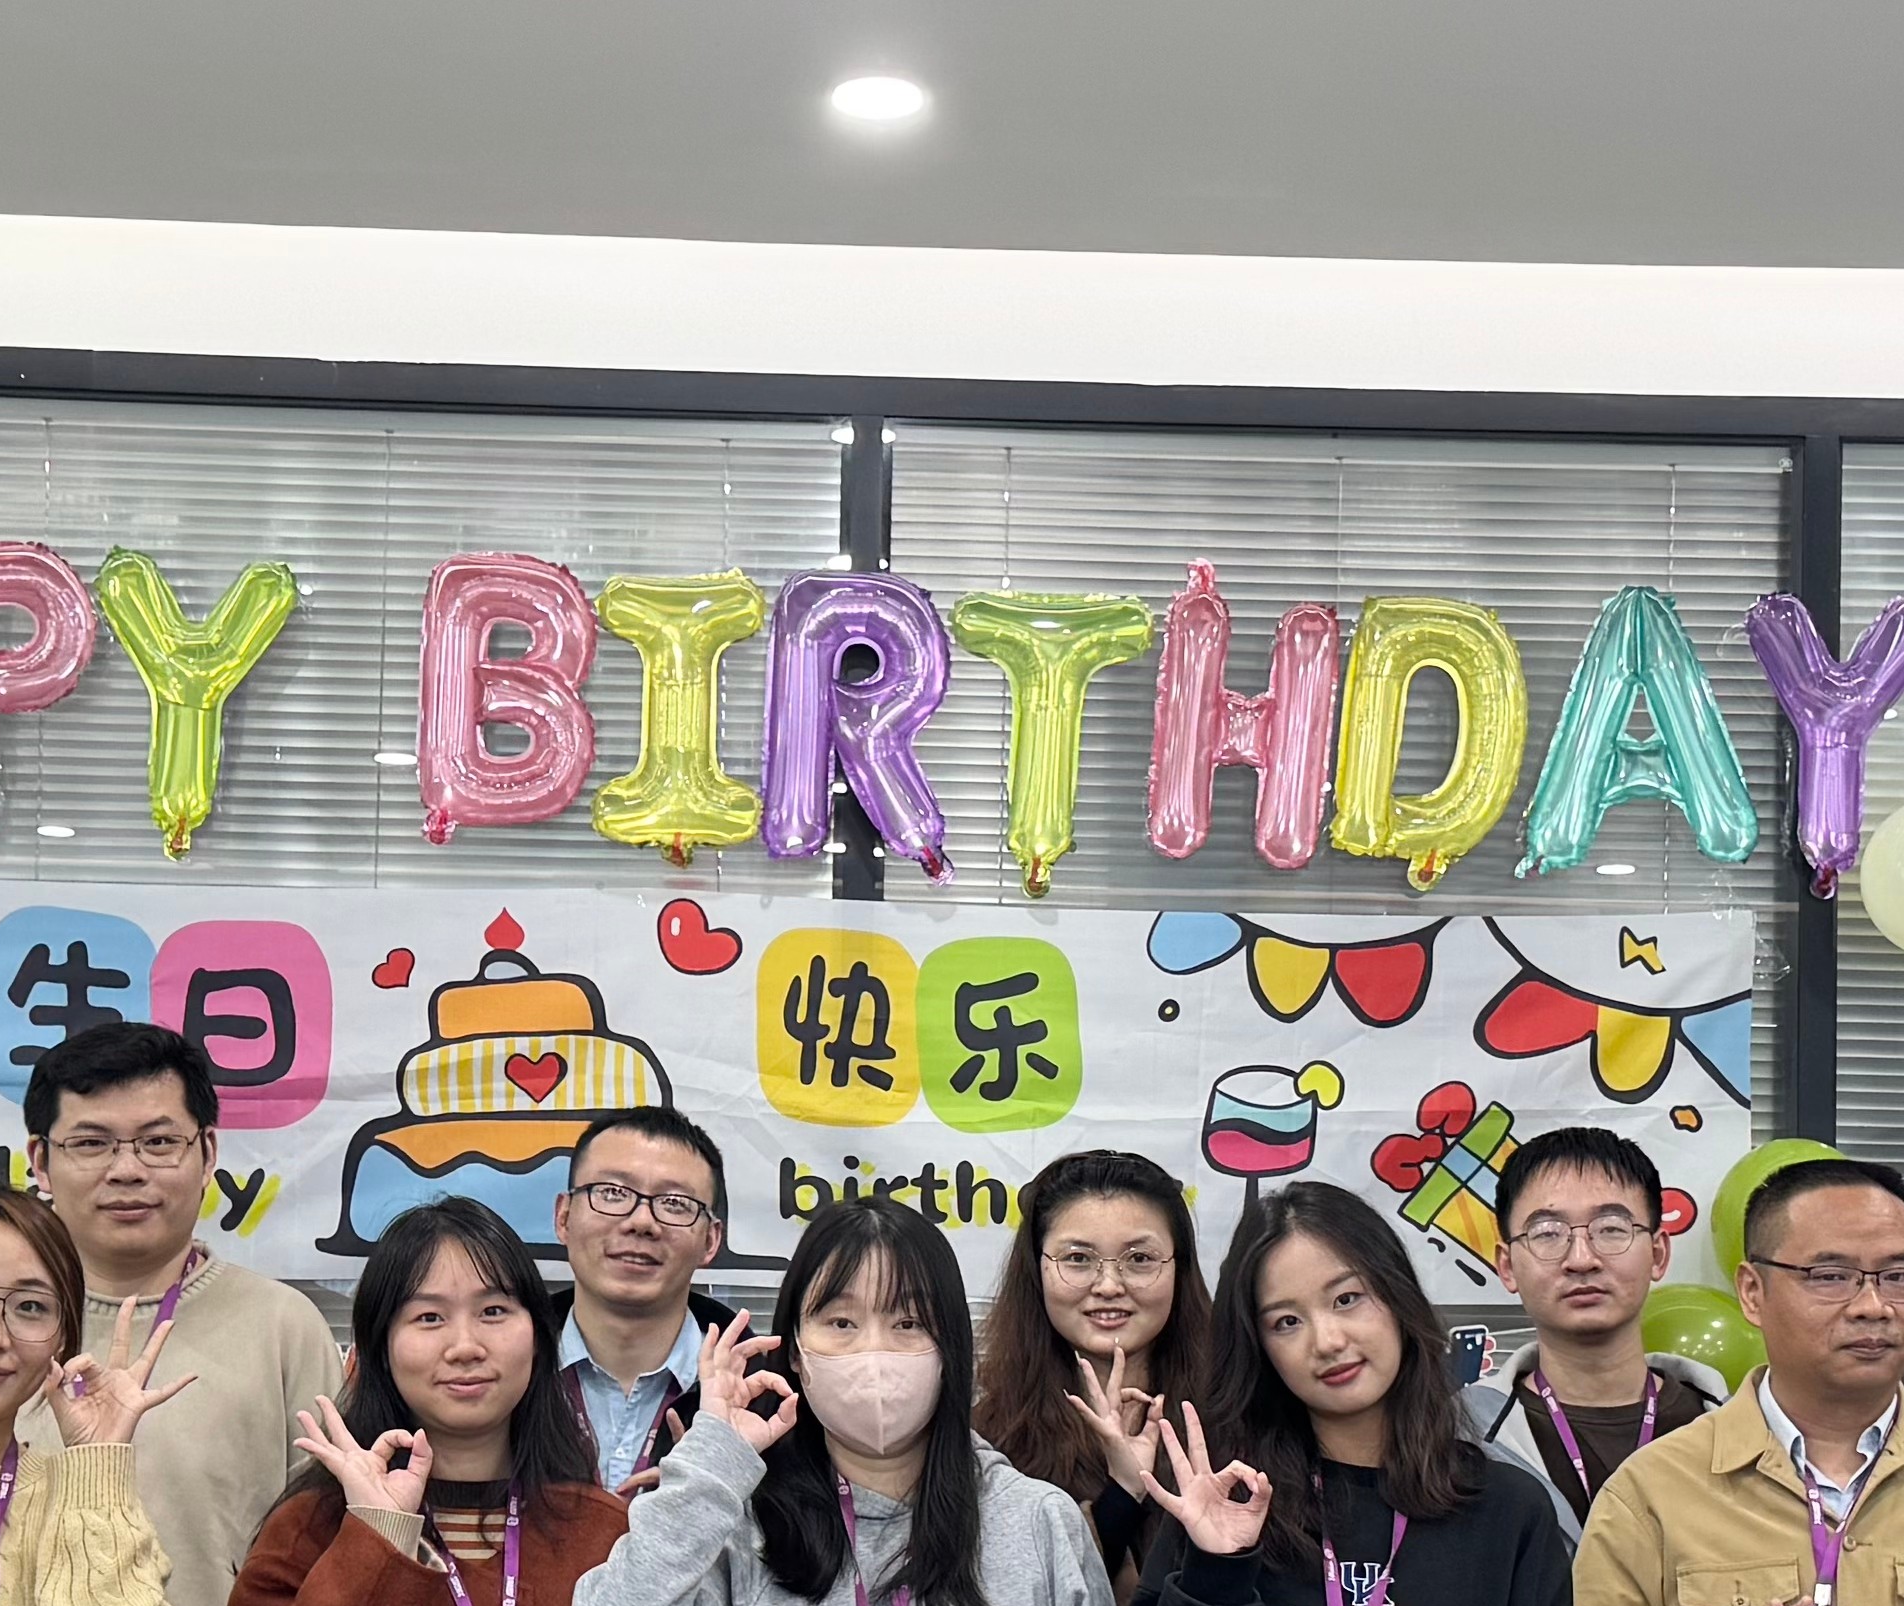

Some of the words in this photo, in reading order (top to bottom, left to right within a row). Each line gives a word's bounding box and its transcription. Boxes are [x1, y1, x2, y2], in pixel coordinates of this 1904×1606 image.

[7, 940, 296, 1088] 生日
[782, 954, 1059, 1101] 快乐
[780, 1156, 1034, 1226] birth
